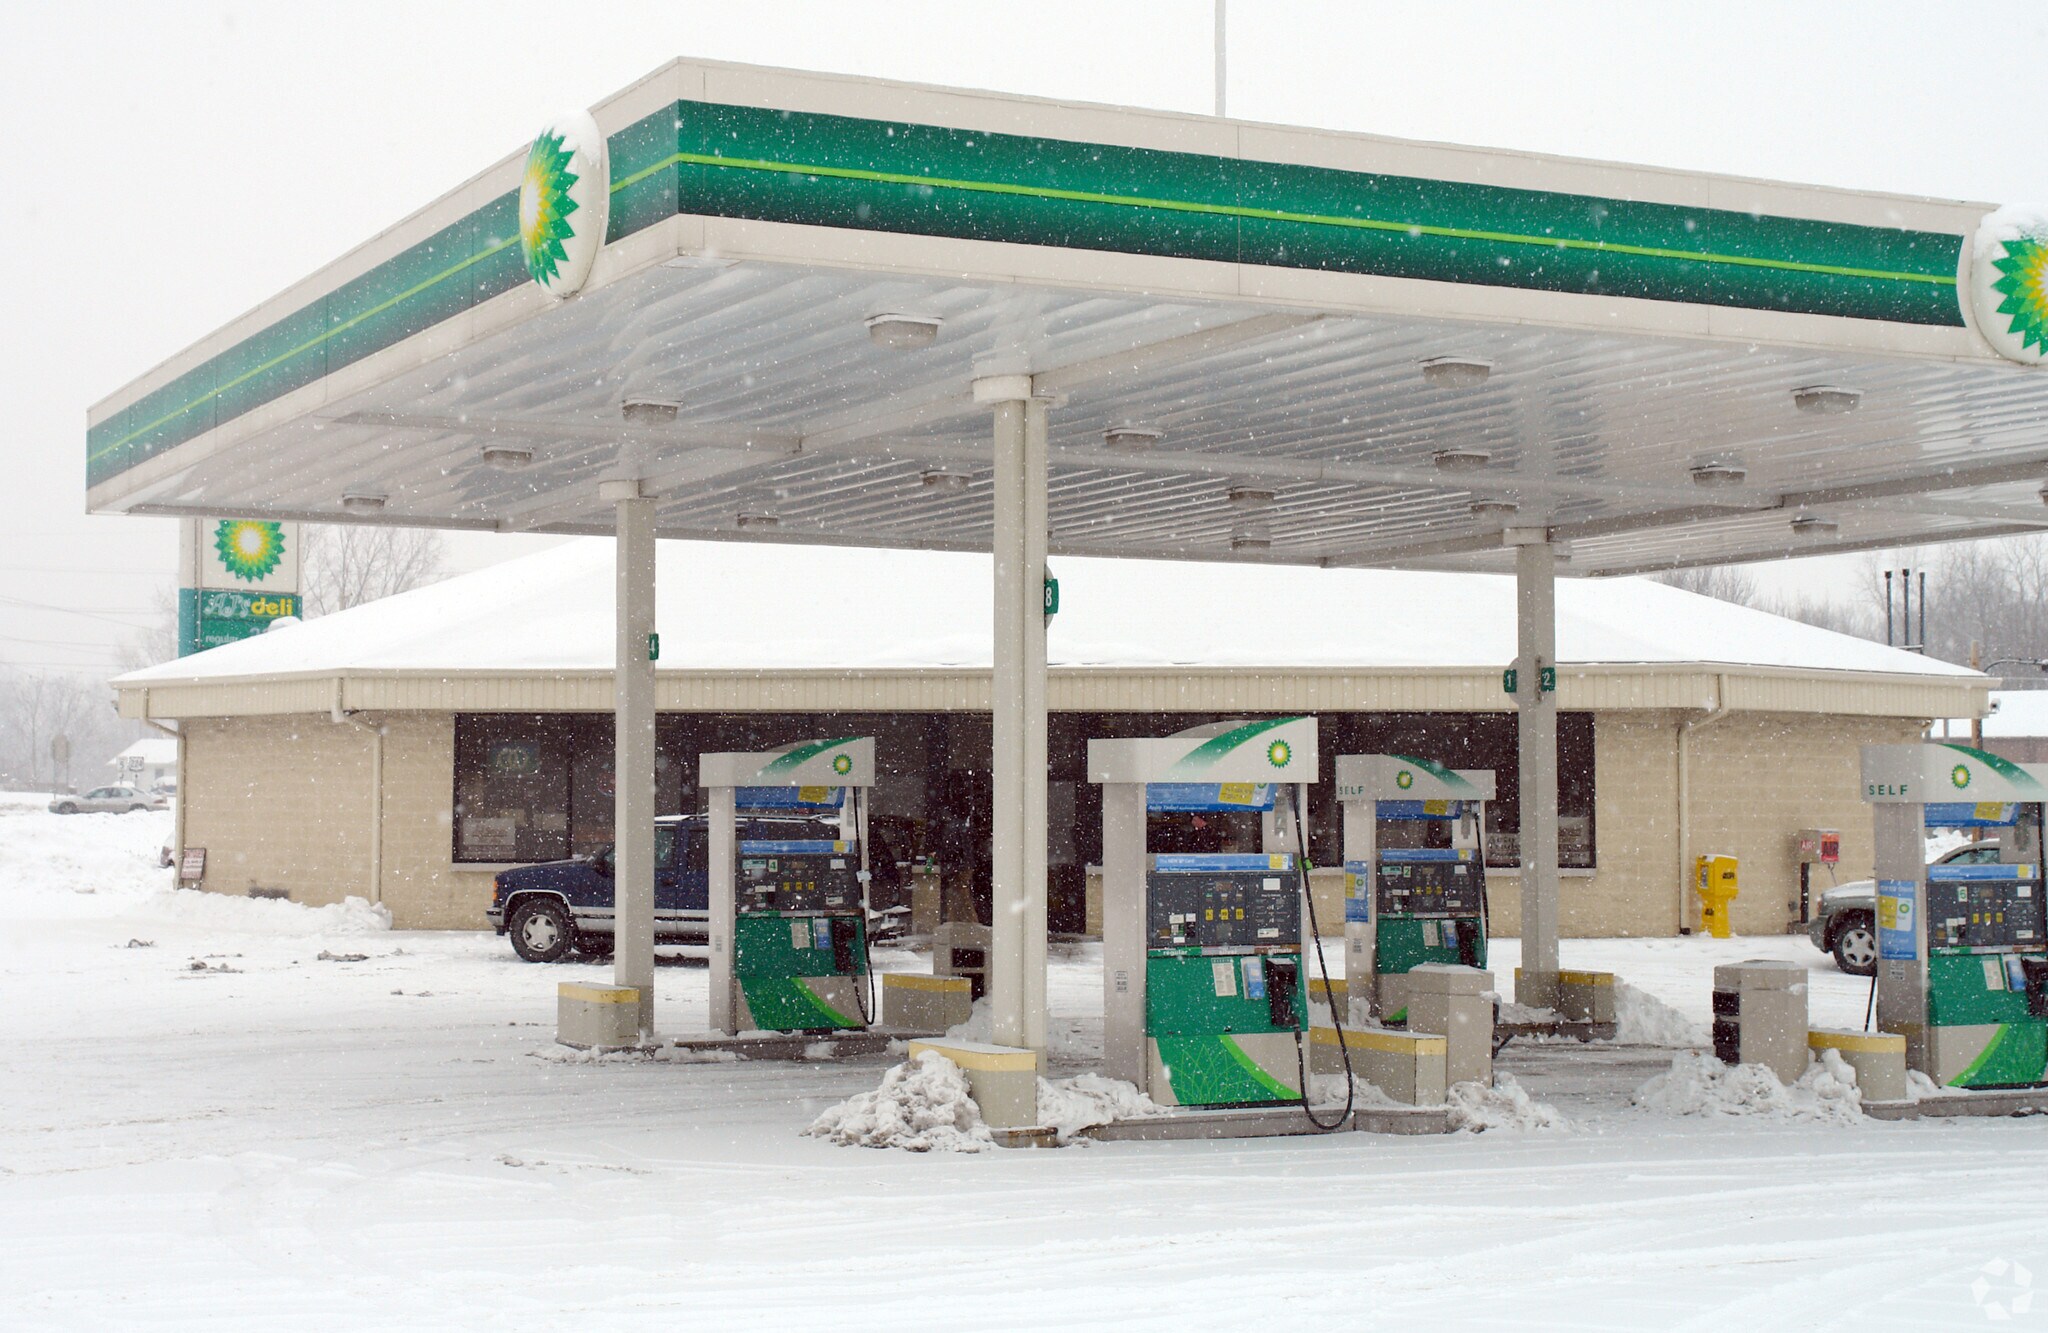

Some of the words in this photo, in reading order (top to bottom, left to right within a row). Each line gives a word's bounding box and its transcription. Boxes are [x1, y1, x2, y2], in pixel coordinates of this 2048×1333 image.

[1045, 587, 1052, 607] 8
[251, 597, 293, 616] deli
[1506, 674, 1512, 687] 1
[1543, 672, 1551, 686] 2
[1339, 785, 1365, 795] SELF
[1868, 784, 1908, 796] SELF
[1821, 840, 1839, 857] AIR
[769, 861, 776, 870] 4
[1404, 867, 1410, 876] 2
